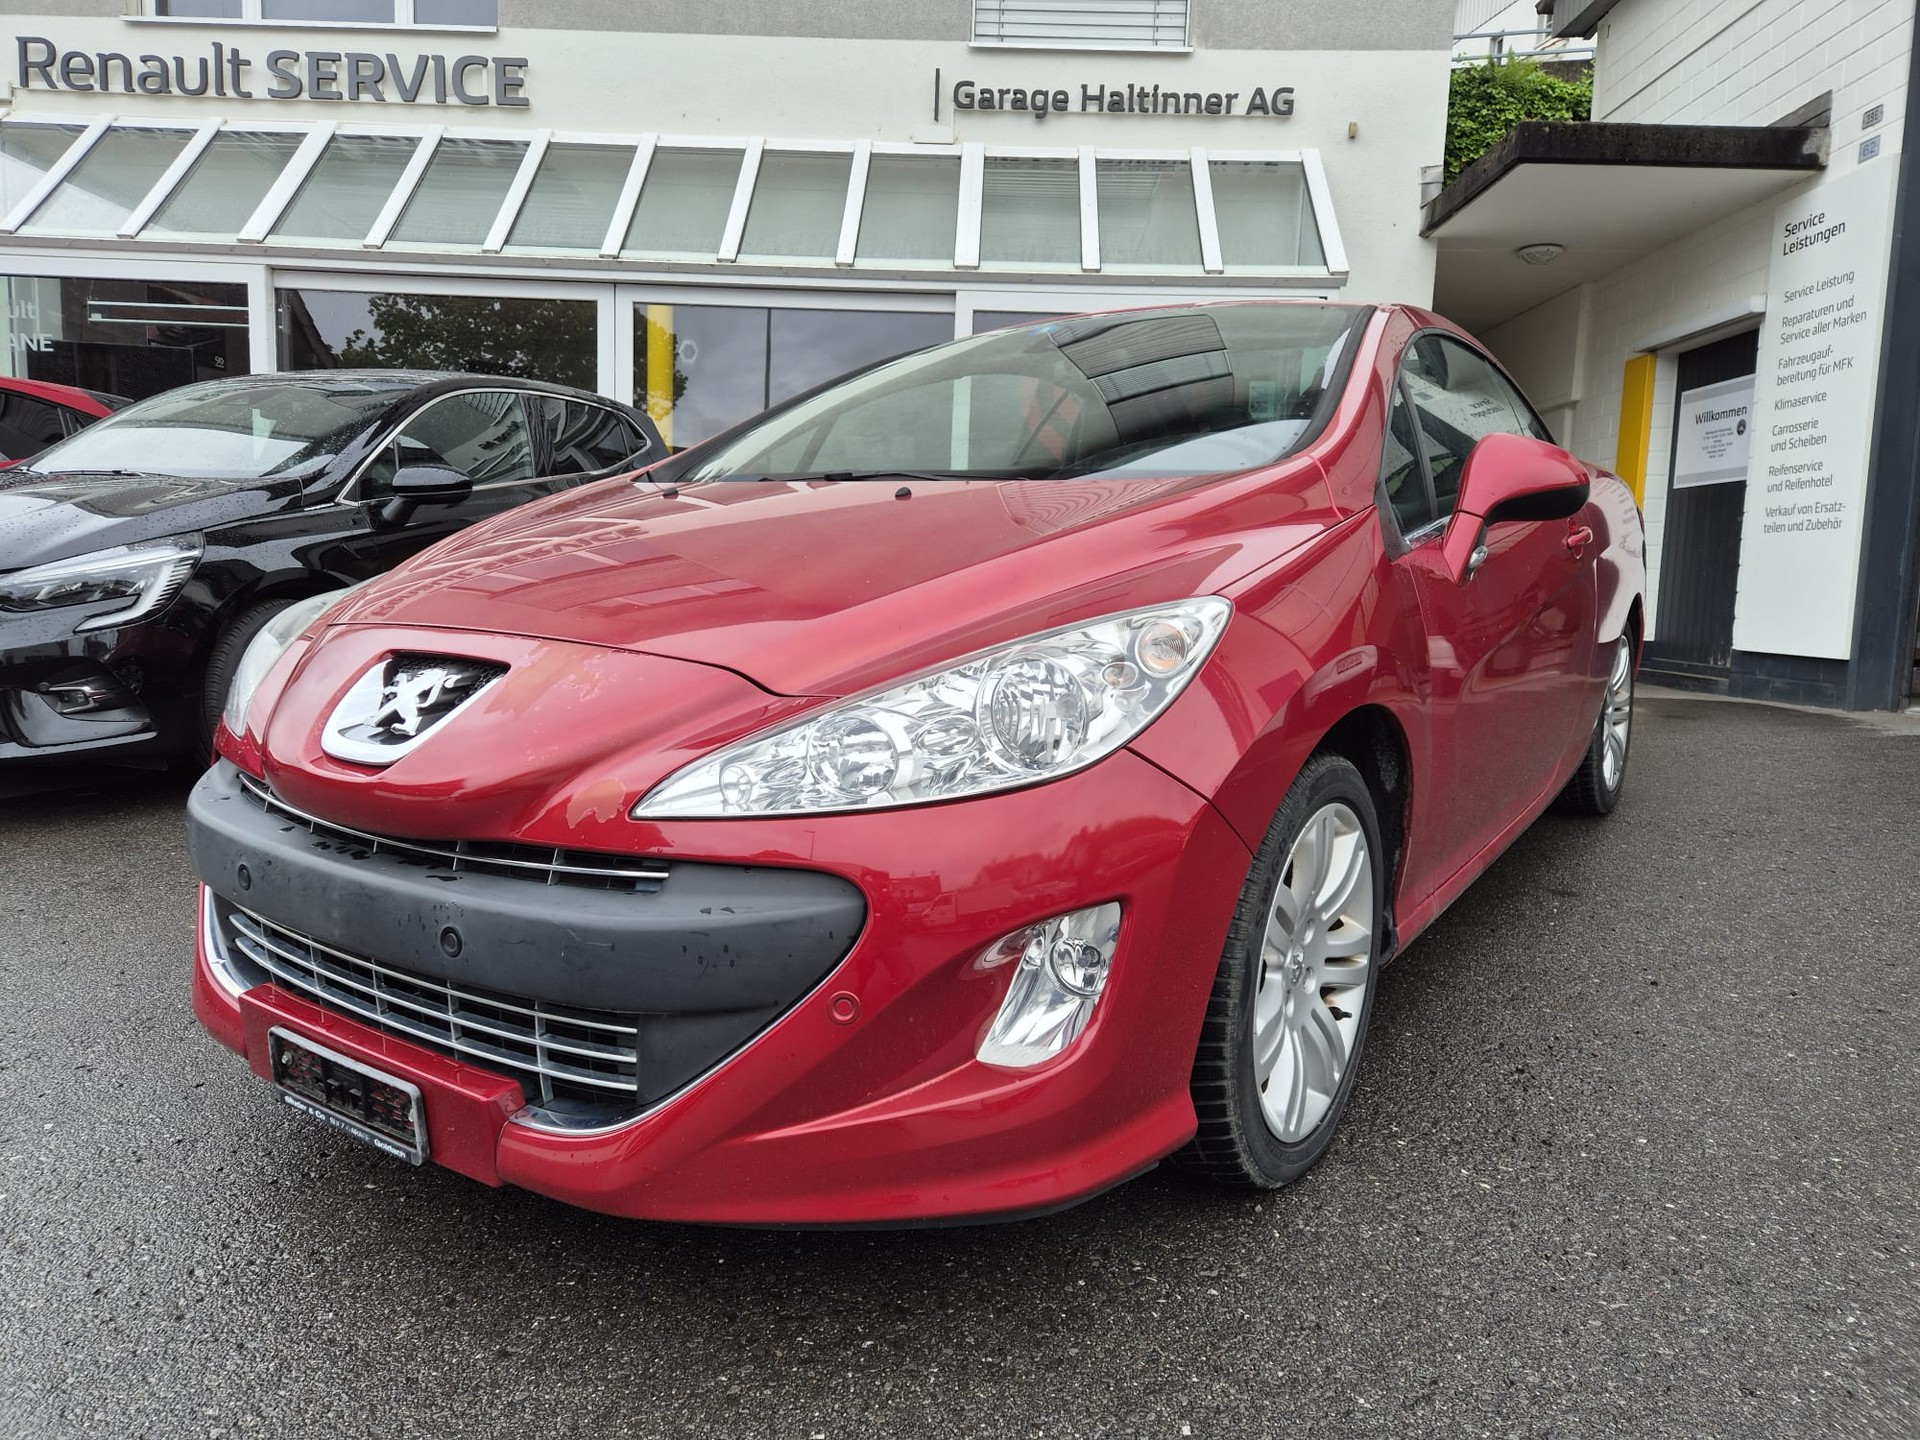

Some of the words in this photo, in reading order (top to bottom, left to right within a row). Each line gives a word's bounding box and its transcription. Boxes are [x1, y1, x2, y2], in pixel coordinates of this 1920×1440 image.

[15, 36, 252, 98] Renault
[266, 50, 531, 107] SERVICE
[953, 80, 1069, 119] Garage
[1081, 83, 1238, 116] Haltinner
[1246, 86, 1295, 117] AG
[1863, 141, 1876, 157] 62
[1784, 212, 1825, 238] Service
[1783, 222, 1846, 256] Leistungen
[1784, 285, 1815, 303] Service
[1816, 271, 1855, 293] Leistung
[1782, 304, 1834, 329] Reparaturen
[1836, 295, 1855, 312] und
[1780, 328, 1810, 345] Service
[1812, 321, 1831, 335] aller
[1833, 310, 1867, 329] Marken
[1778, 344, 1834, 370] Fahrzeugauf-
[1776, 368, 1817, 386] bereitung
[1818, 363, 1832, 377] für
[1833, 356, 1854, 373] MFK
[1774, 391, 1827, 411] Klimaservice
[1695, 405, 1748, 425] Willkommen
[1772, 418, 1819, 437] Carrosserie
[1771, 437, 1787, 452] und
[1788, 433, 1827, 451] Scheiben
[1768, 460, 1824, 477] Reifenservice
[1767, 480, 1783, 493] und
[1785, 474, 1833, 491] Reifenhotel
[1765, 503, 1796, 518] Verkauf
[1797, 505, 1813, 515] von
[1815, 501, 1847, 514] Ersatz-
[1764, 521, 1786, 534] teilen
[1787, 519, 1804, 532] und
[1805, 516, 1843, 531] Zubehör
